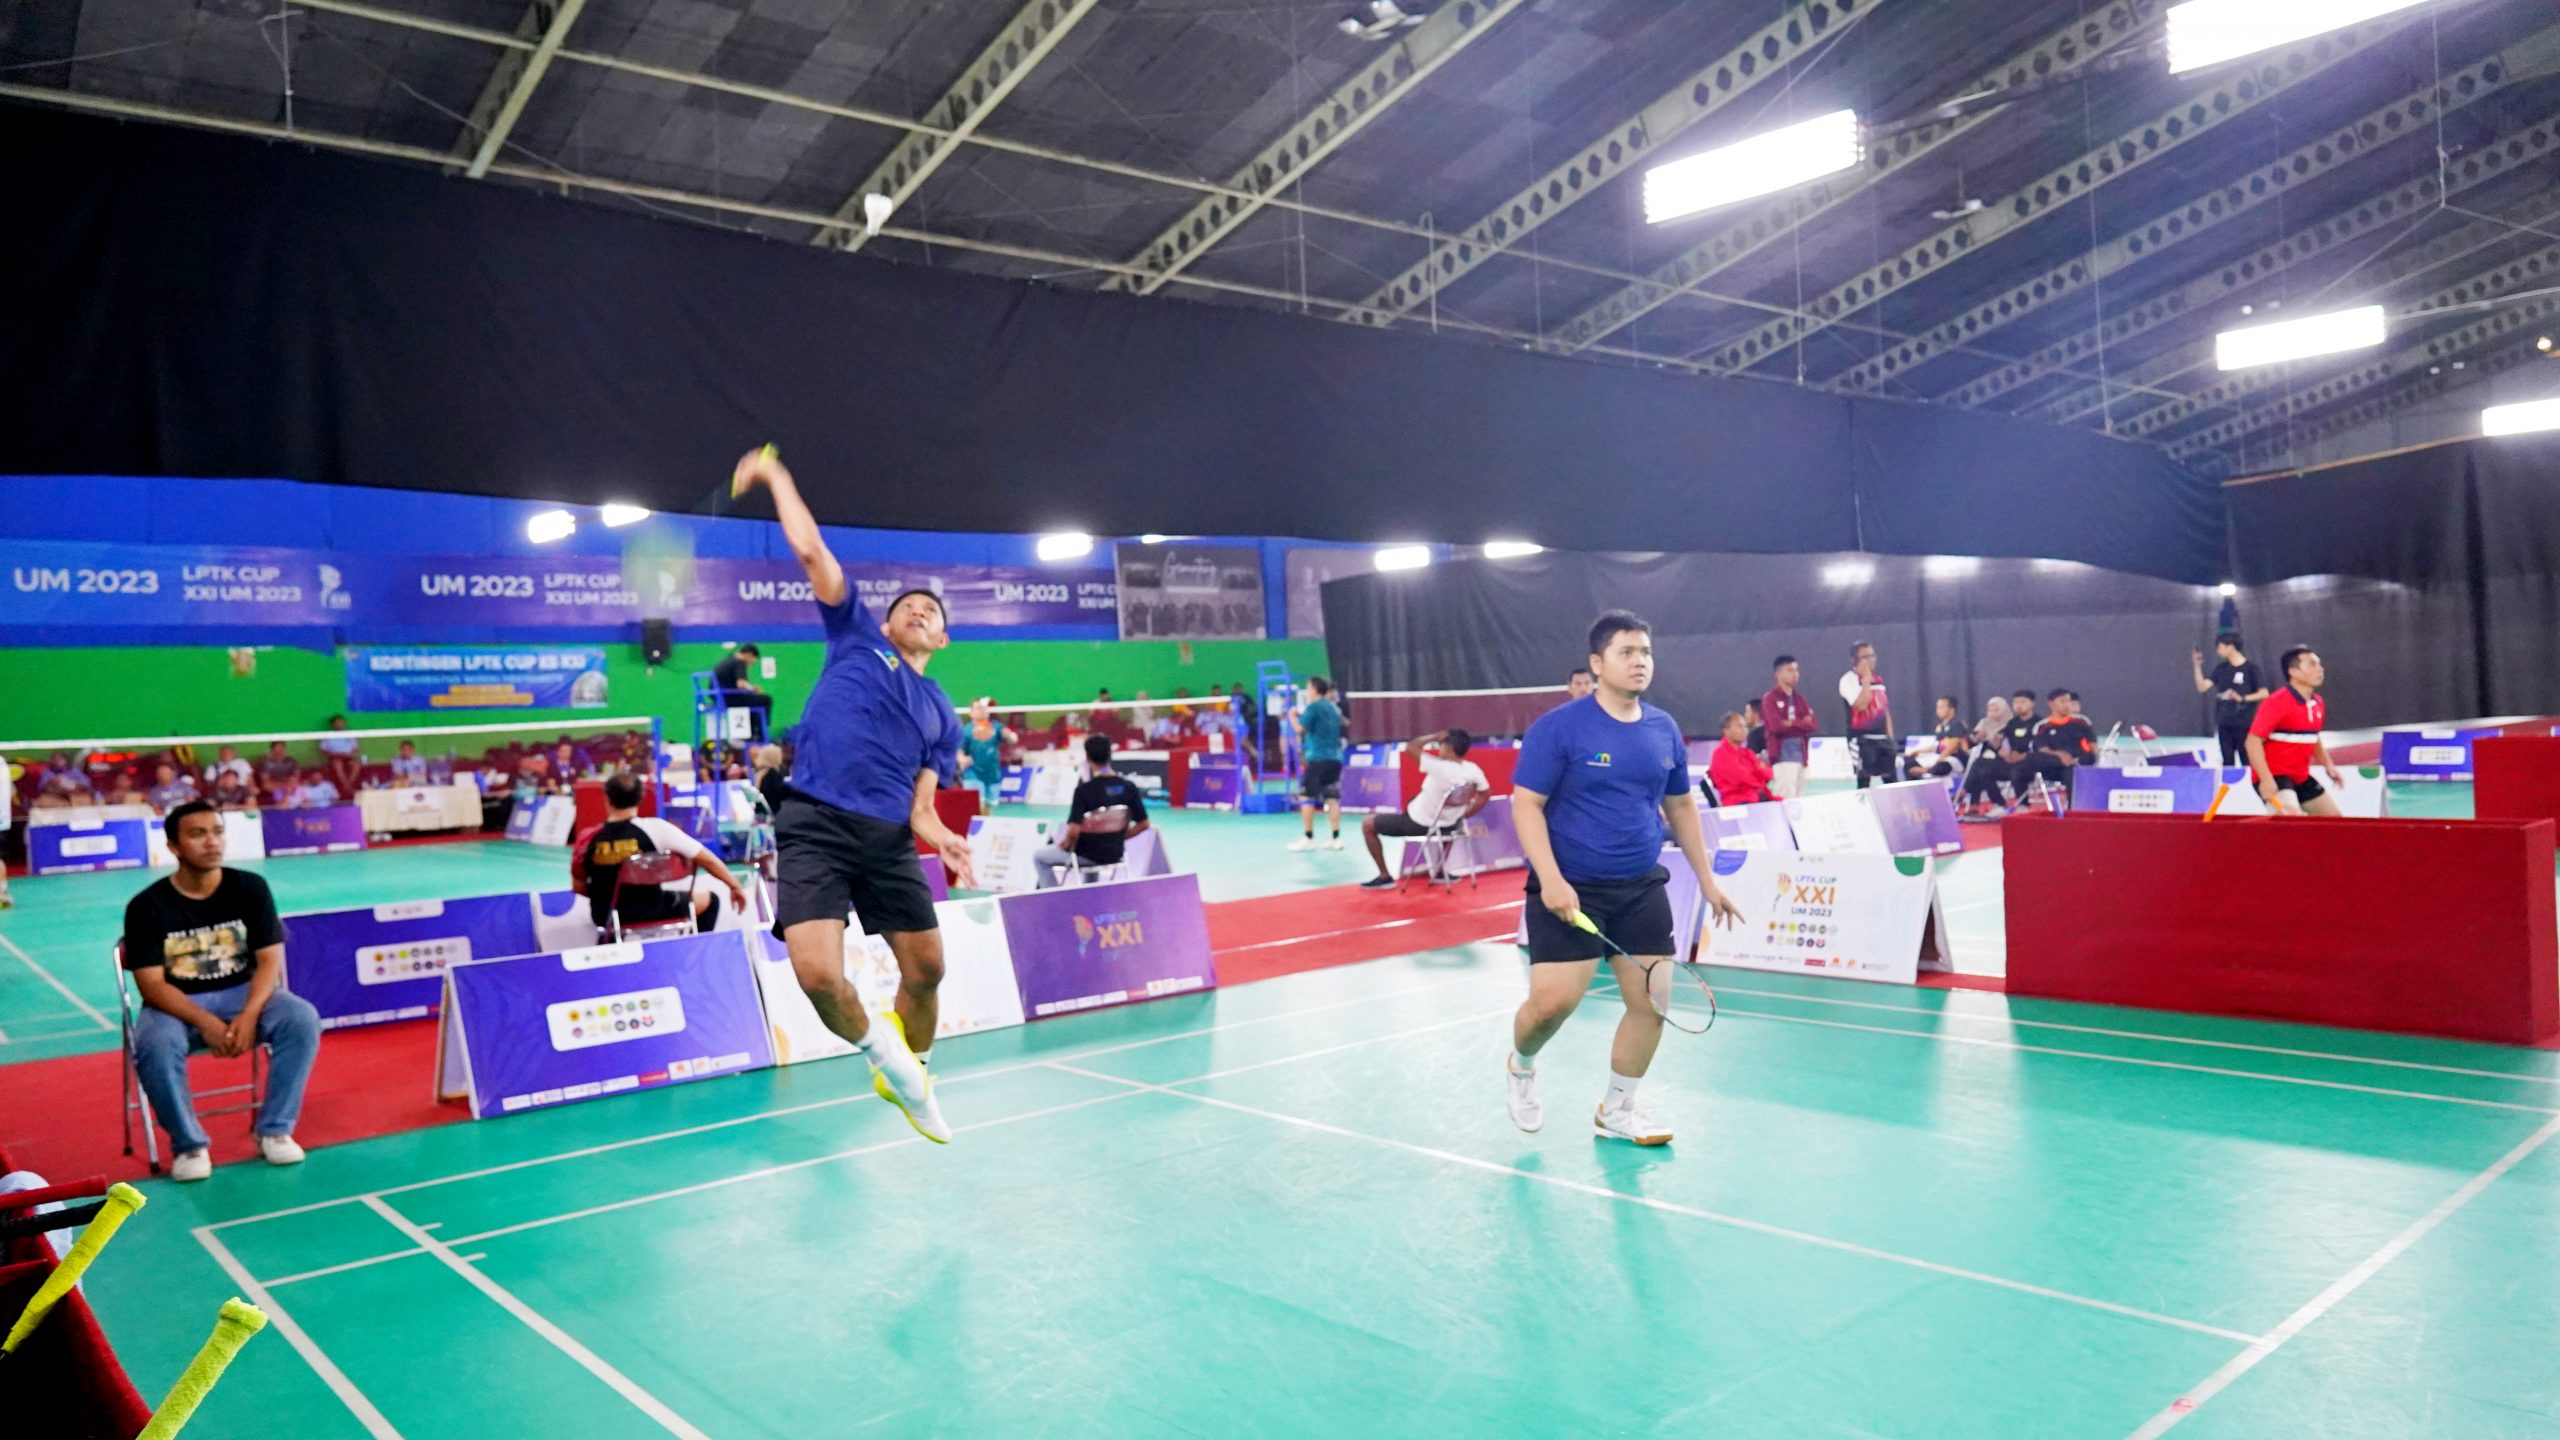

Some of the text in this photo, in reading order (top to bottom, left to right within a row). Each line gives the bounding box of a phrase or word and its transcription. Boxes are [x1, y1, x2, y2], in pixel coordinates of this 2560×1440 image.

[14, 567, 159, 594] UM 2023
[182, 565, 280, 583] LPTK CUP
[544, 573, 621, 588] LPTK CUP
[183, 584, 302, 602] XXI UM 2023
[421, 574, 534, 597] UM 2023
[739, 581, 816, 600] UM 202
[875, 580, 902, 594] CUP
[993, 584, 1069, 602] UM 2023
[574, 591, 600, 606] UM
[602, 591, 640, 607] 2023
[464, 655, 502, 671] LPTK
[504, 655, 536, 671] CUP
[1795, 875, 1837, 884] LPTK CUP
[1793, 884, 1835, 905] XXI
[1791, 906, 1833, 917] UM 2023
[1097, 921, 1143, 948] XXI
